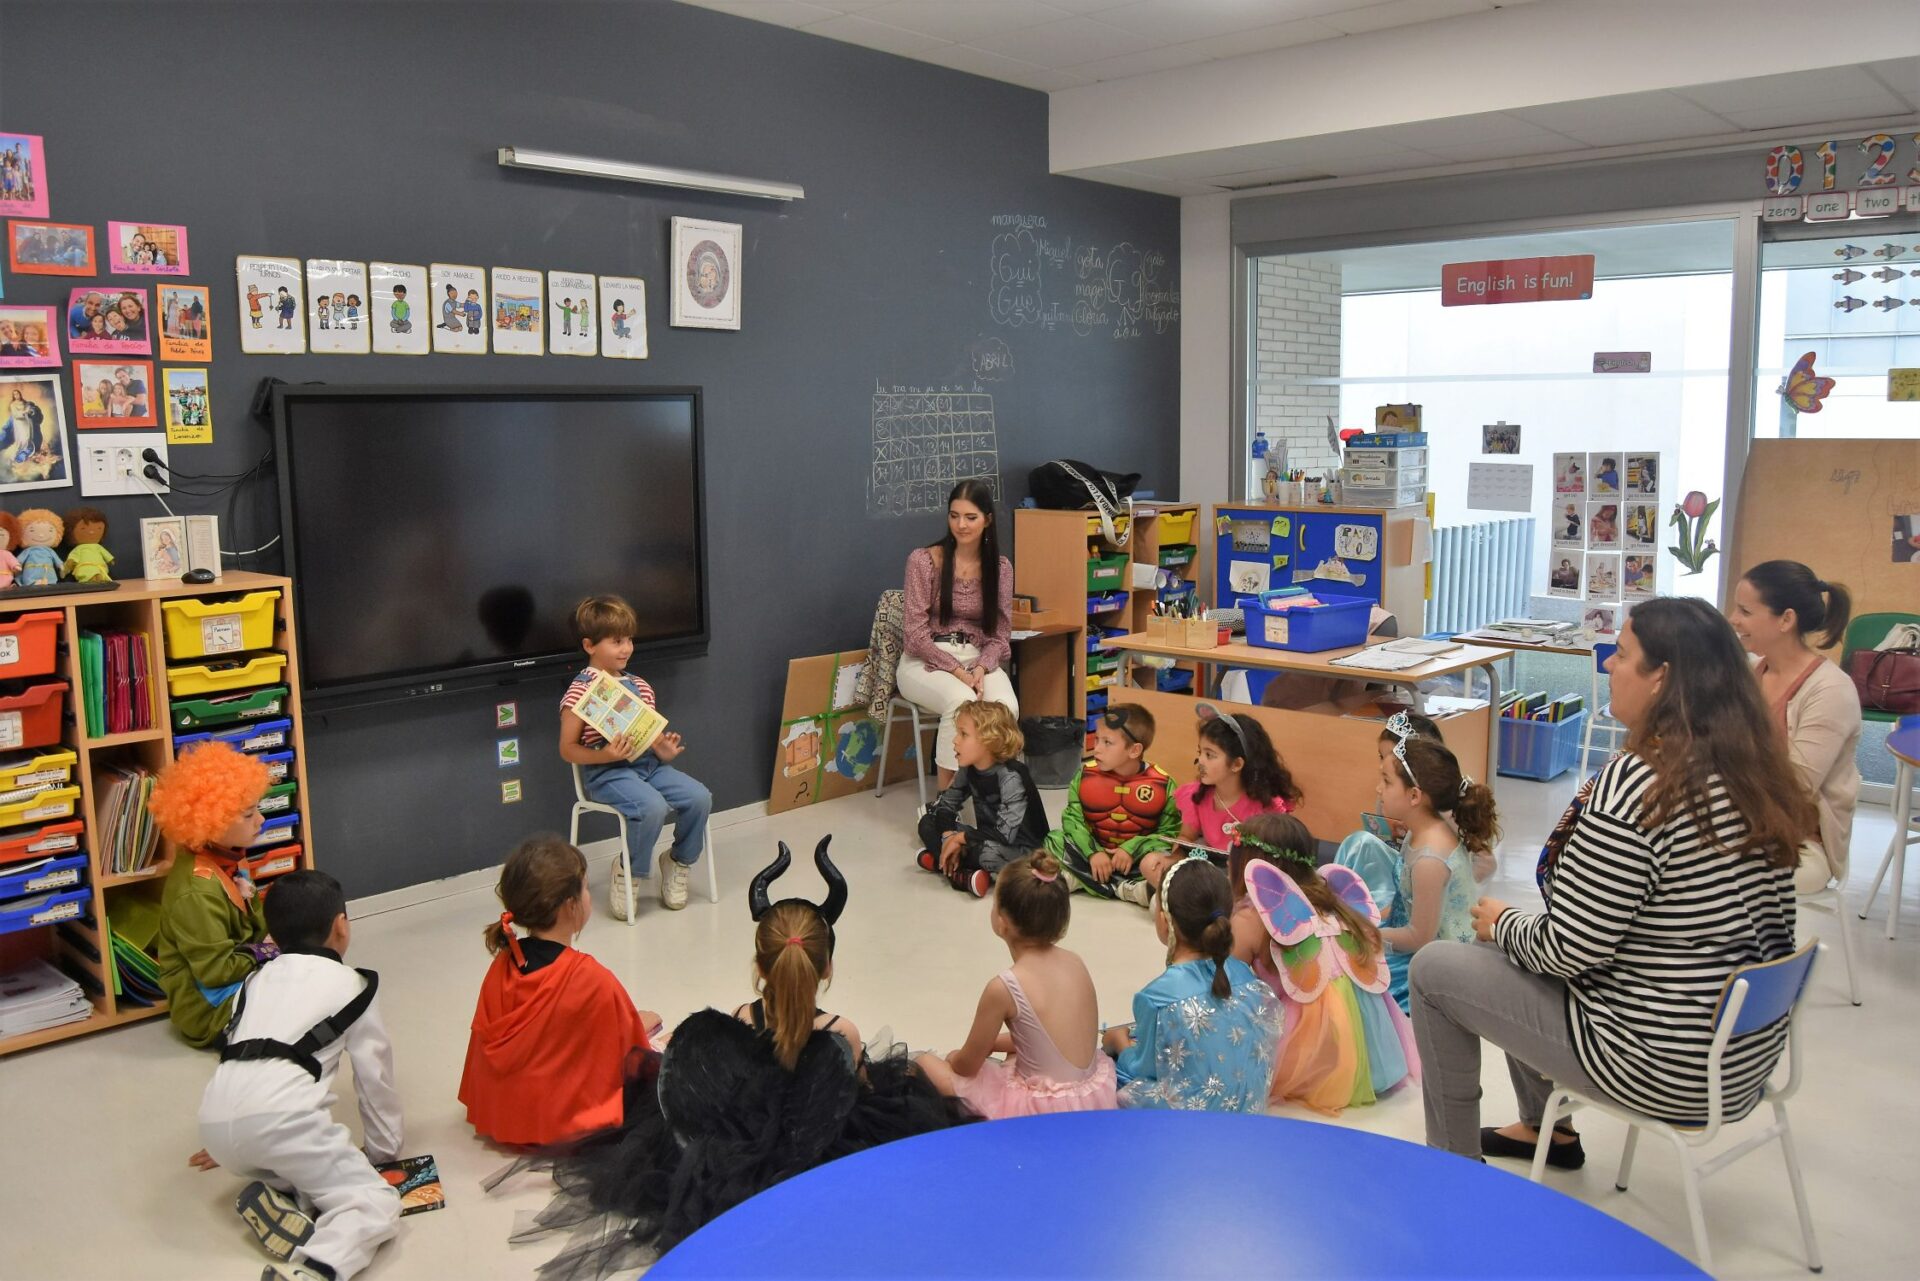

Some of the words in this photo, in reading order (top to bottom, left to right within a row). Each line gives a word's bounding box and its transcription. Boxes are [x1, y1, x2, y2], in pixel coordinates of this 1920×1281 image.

[1815, 202, 1840, 213] one
[1864, 198, 1890, 209] two
[1768, 207, 1797, 218] zero
[453, 272, 475, 280] AMABLE
[1457, 273, 1516, 296] English
[1524, 273, 1538, 289] is
[1540, 271, 1574, 290] fun!
[1139, 787, 1151, 800] R
